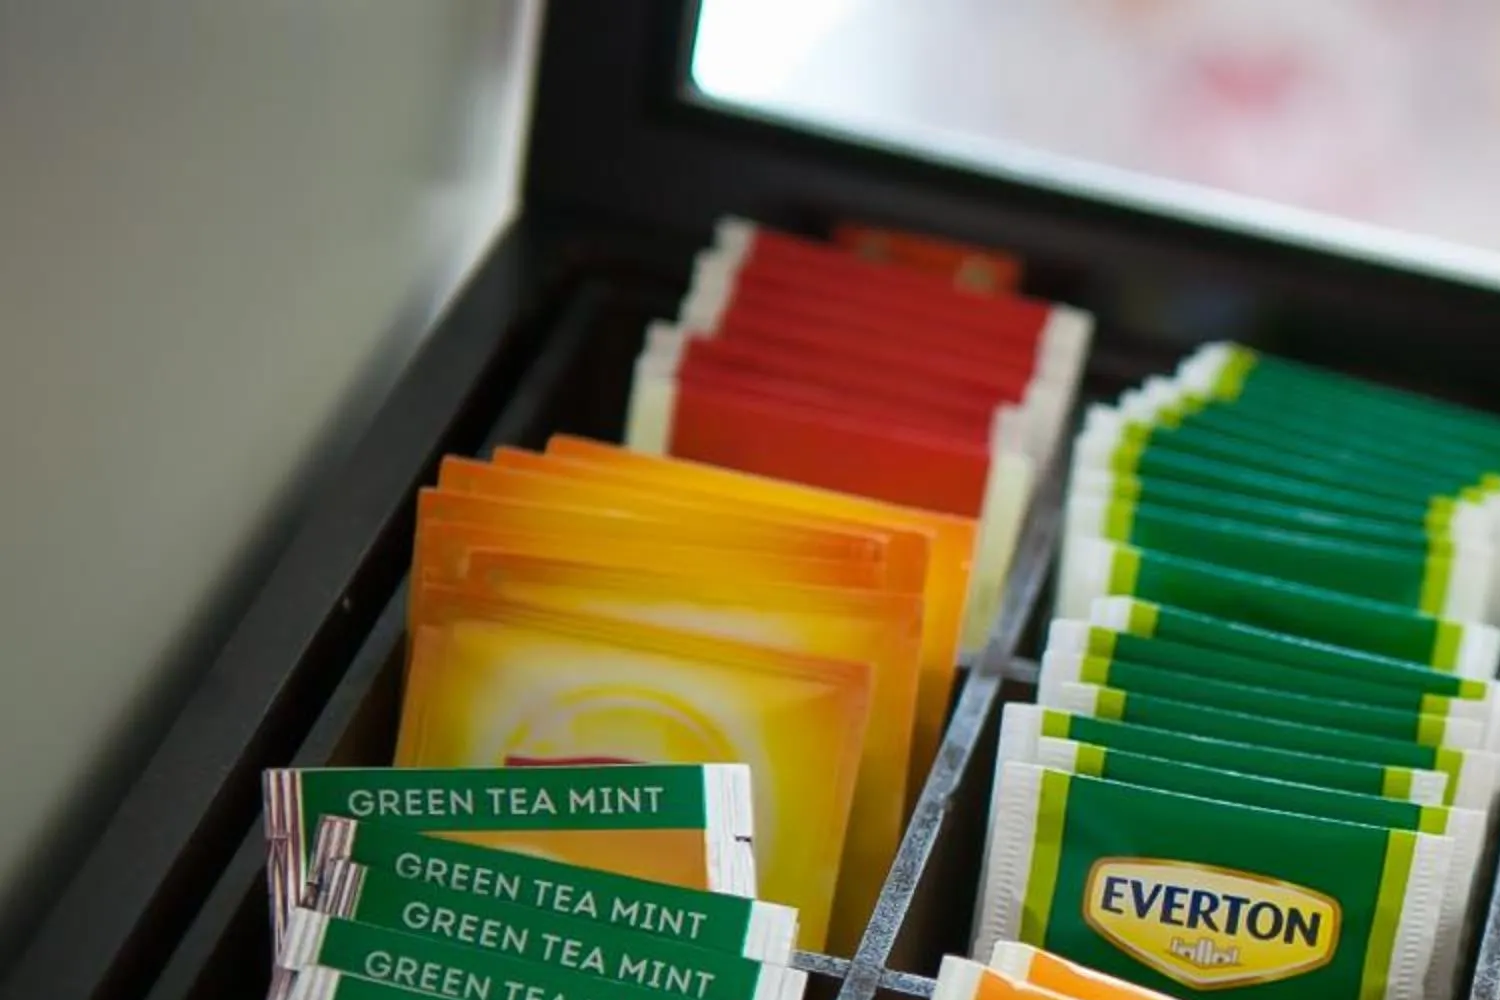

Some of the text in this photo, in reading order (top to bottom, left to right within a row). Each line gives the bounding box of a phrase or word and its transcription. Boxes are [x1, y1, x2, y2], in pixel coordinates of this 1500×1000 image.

[347, 786, 665, 816] GREEN TEA MINT
[395, 852, 707, 940] GREEN TEA MINT
[1101, 875, 1322, 947] EVERTON
[364, 951, 492, 1000] GREEN
[402, 902, 716, 999] GREEN TEA MINT
